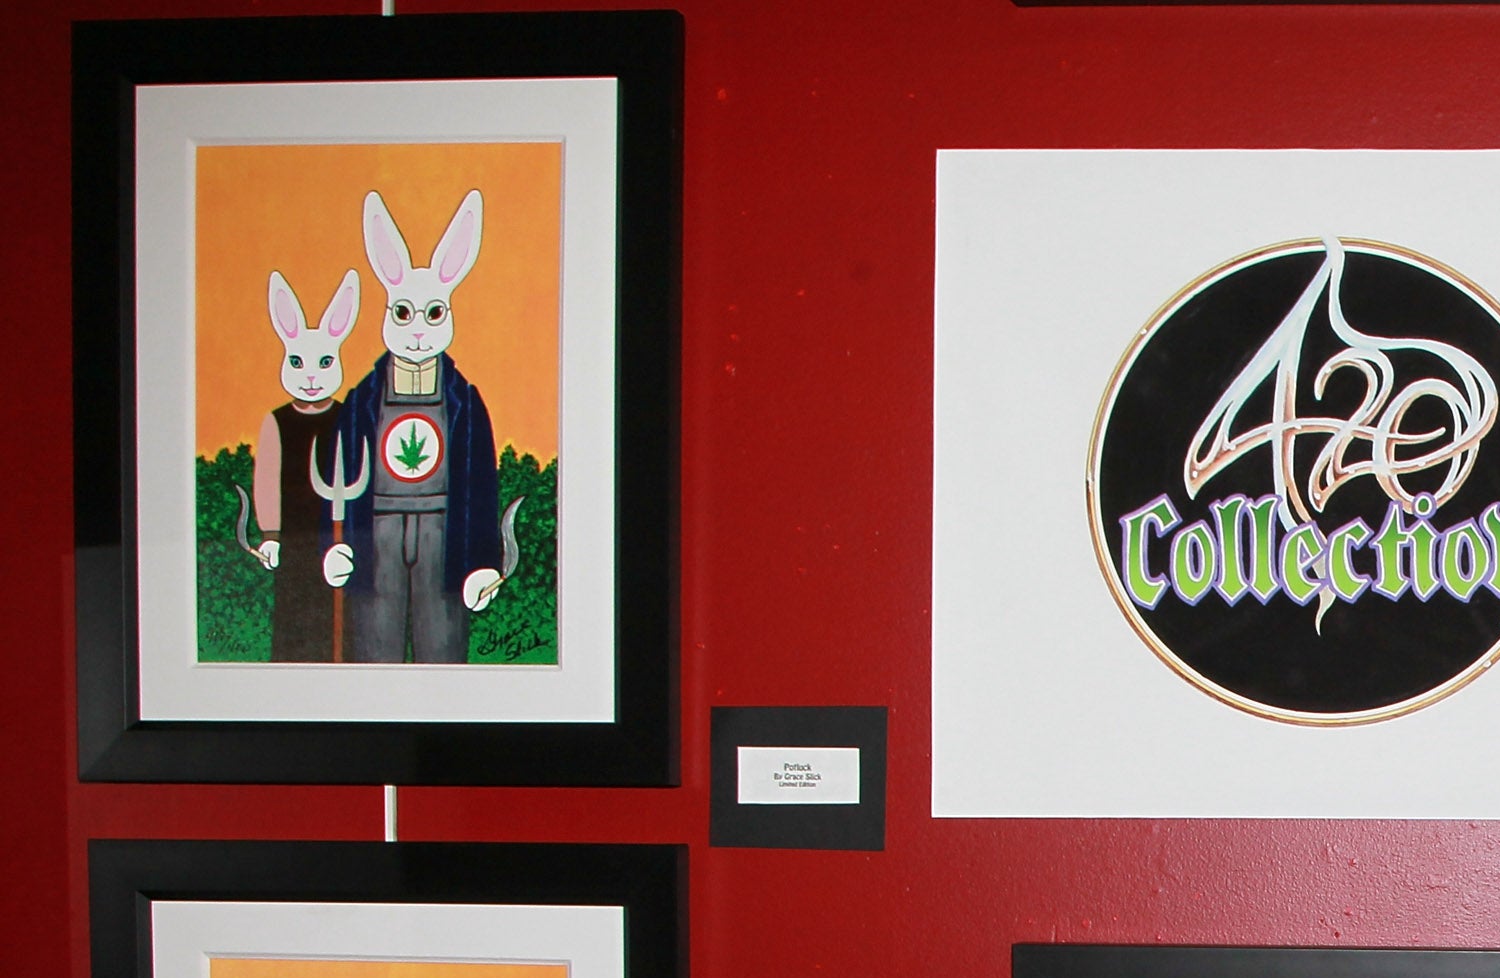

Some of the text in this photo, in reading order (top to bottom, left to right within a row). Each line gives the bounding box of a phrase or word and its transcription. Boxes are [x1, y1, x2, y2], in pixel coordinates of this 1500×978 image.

[1183, 236, 1499, 530] 420
[784, 763, 811, 772] Potluck
[785, 772, 804, 781] Grace
[806, 772, 822, 781] Slick
